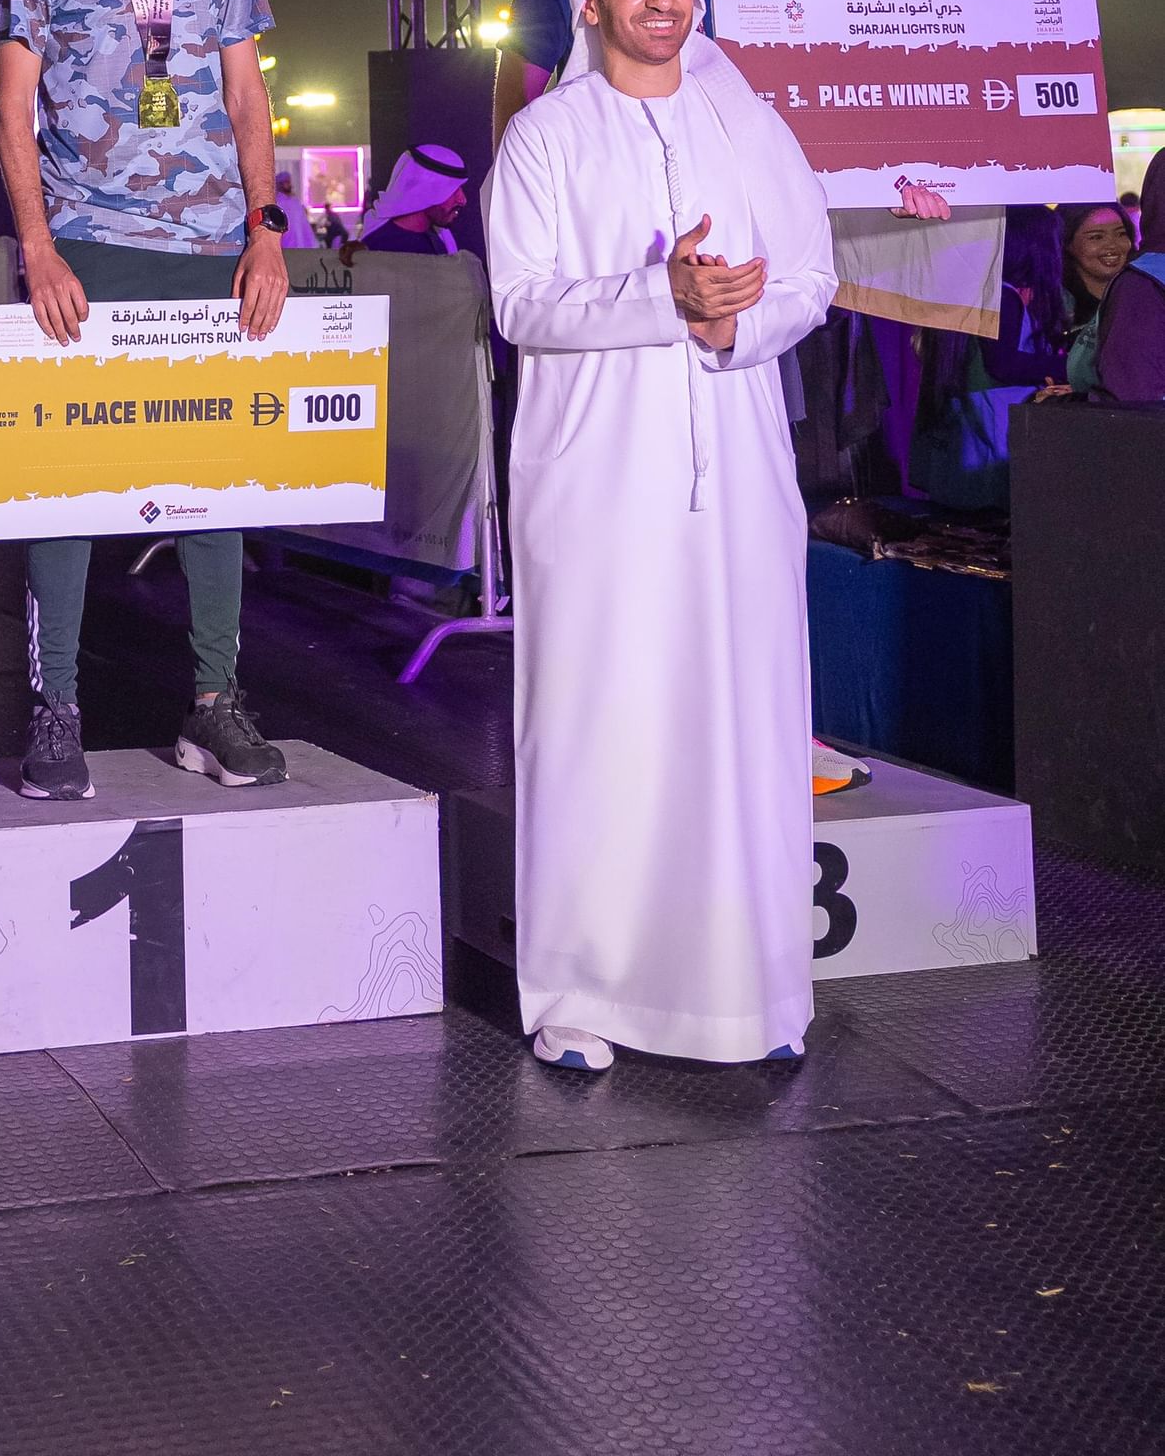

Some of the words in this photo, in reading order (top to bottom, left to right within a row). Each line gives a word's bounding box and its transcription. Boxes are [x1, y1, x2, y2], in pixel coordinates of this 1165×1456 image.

[846, 0, 895, 16] الشارقة
[935, 4, 962, 19] جري
[849, 24, 900, 35] SHARJAH
[901, 23, 941, 34] LIGHTS
[942, 23, 965, 34] RUN
[818, 84, 883, 107] PLACE
[887, 83, 970, 106] WINNER
[1034, 81, 1079, 109] 500
[111, 308, 166, 325] الشارقة
[170, 304, 209, 324] أضواء
[212, 311, 241, 327] جري
[111, 333, 169, 346] SHARJAH
[171, 332, 214, 345] LIGHTS
[216, 331, 242, 344] RUN
[7, 411, 18, 419] THE
[65, 401, 136, 426] PLACE
[143, 398, 234, 422] WINNER
[304, 393, 361, 424] 1000
[165, 505, 208, 516] Endurance
[69, 817, 188, 1037] 1
